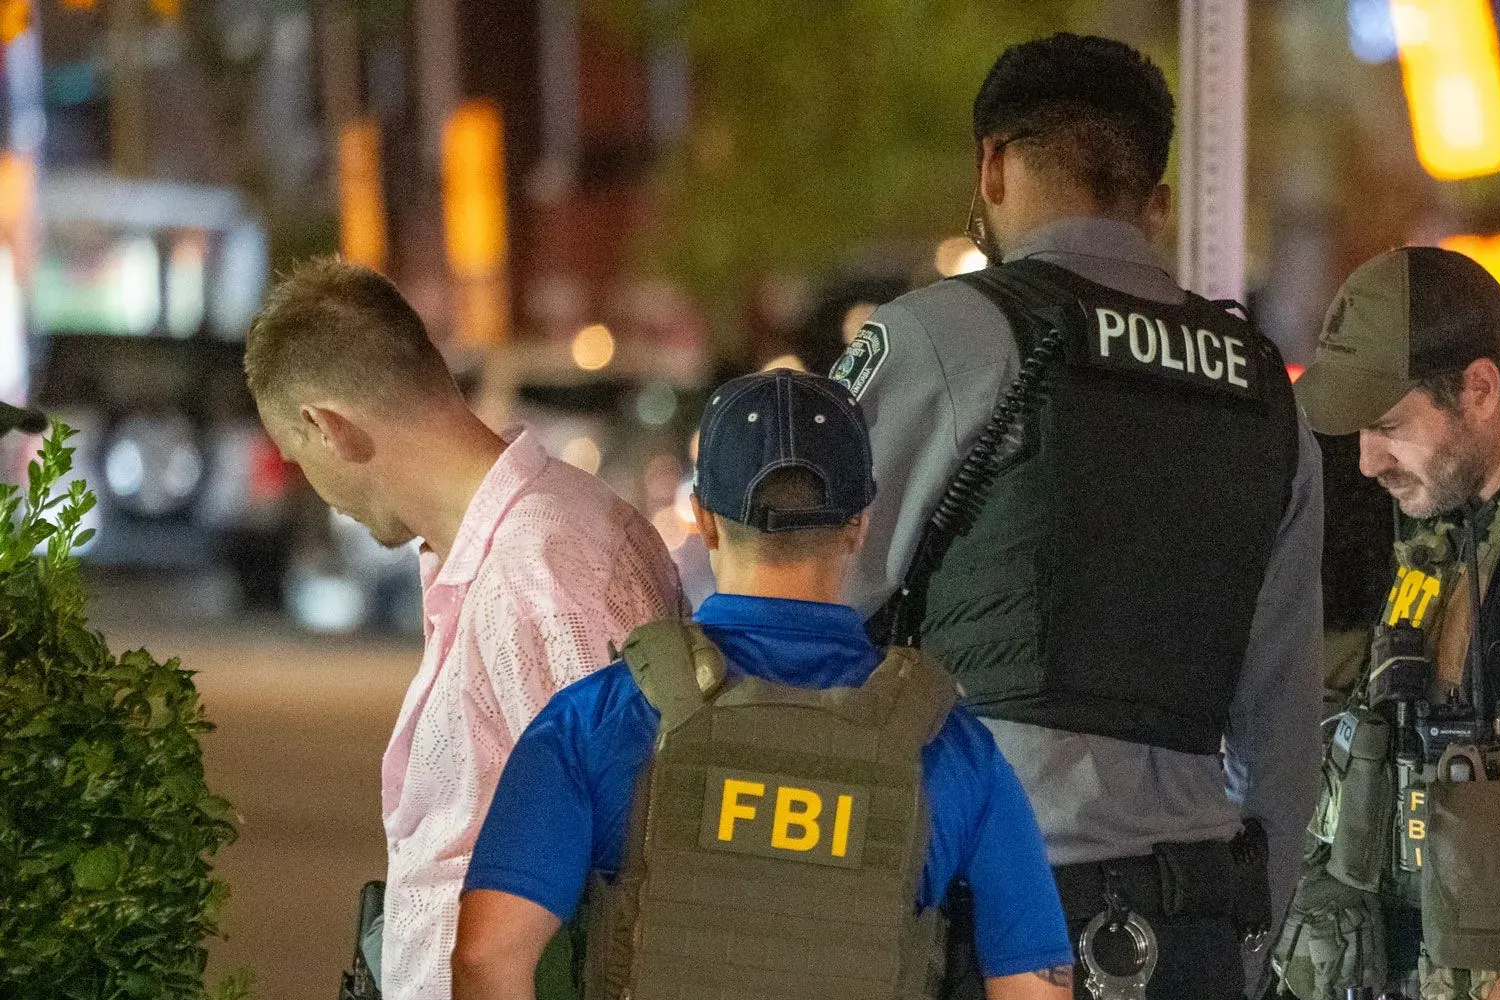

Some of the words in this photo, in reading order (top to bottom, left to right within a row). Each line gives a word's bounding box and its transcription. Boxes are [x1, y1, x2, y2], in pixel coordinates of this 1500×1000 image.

[1096, 308, 1247, 388] POLICE
[717, 778, 852, 858] FBI
[1408, 790, 1426, 867] FBI
